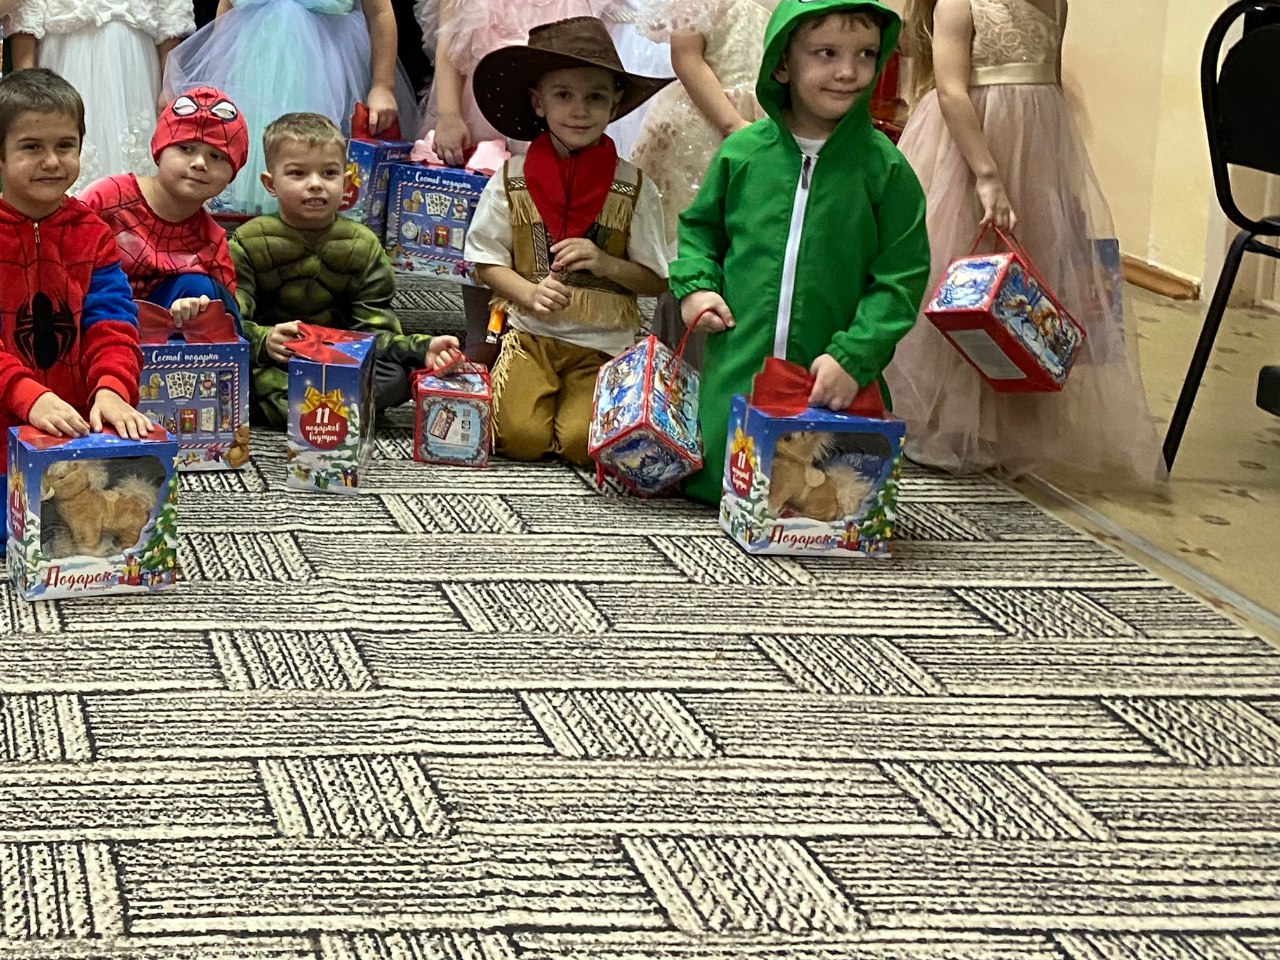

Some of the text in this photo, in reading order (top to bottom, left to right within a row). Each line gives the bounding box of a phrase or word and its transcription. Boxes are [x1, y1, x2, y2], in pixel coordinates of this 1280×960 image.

[152, 350, 219, 363] Состав подарка
[315, 407, 330, 424] 11
[305, 423, 340, 434] подарков
[769, 524, 832, 548] Подарок
[45, 566, 113, 589] Подарок
